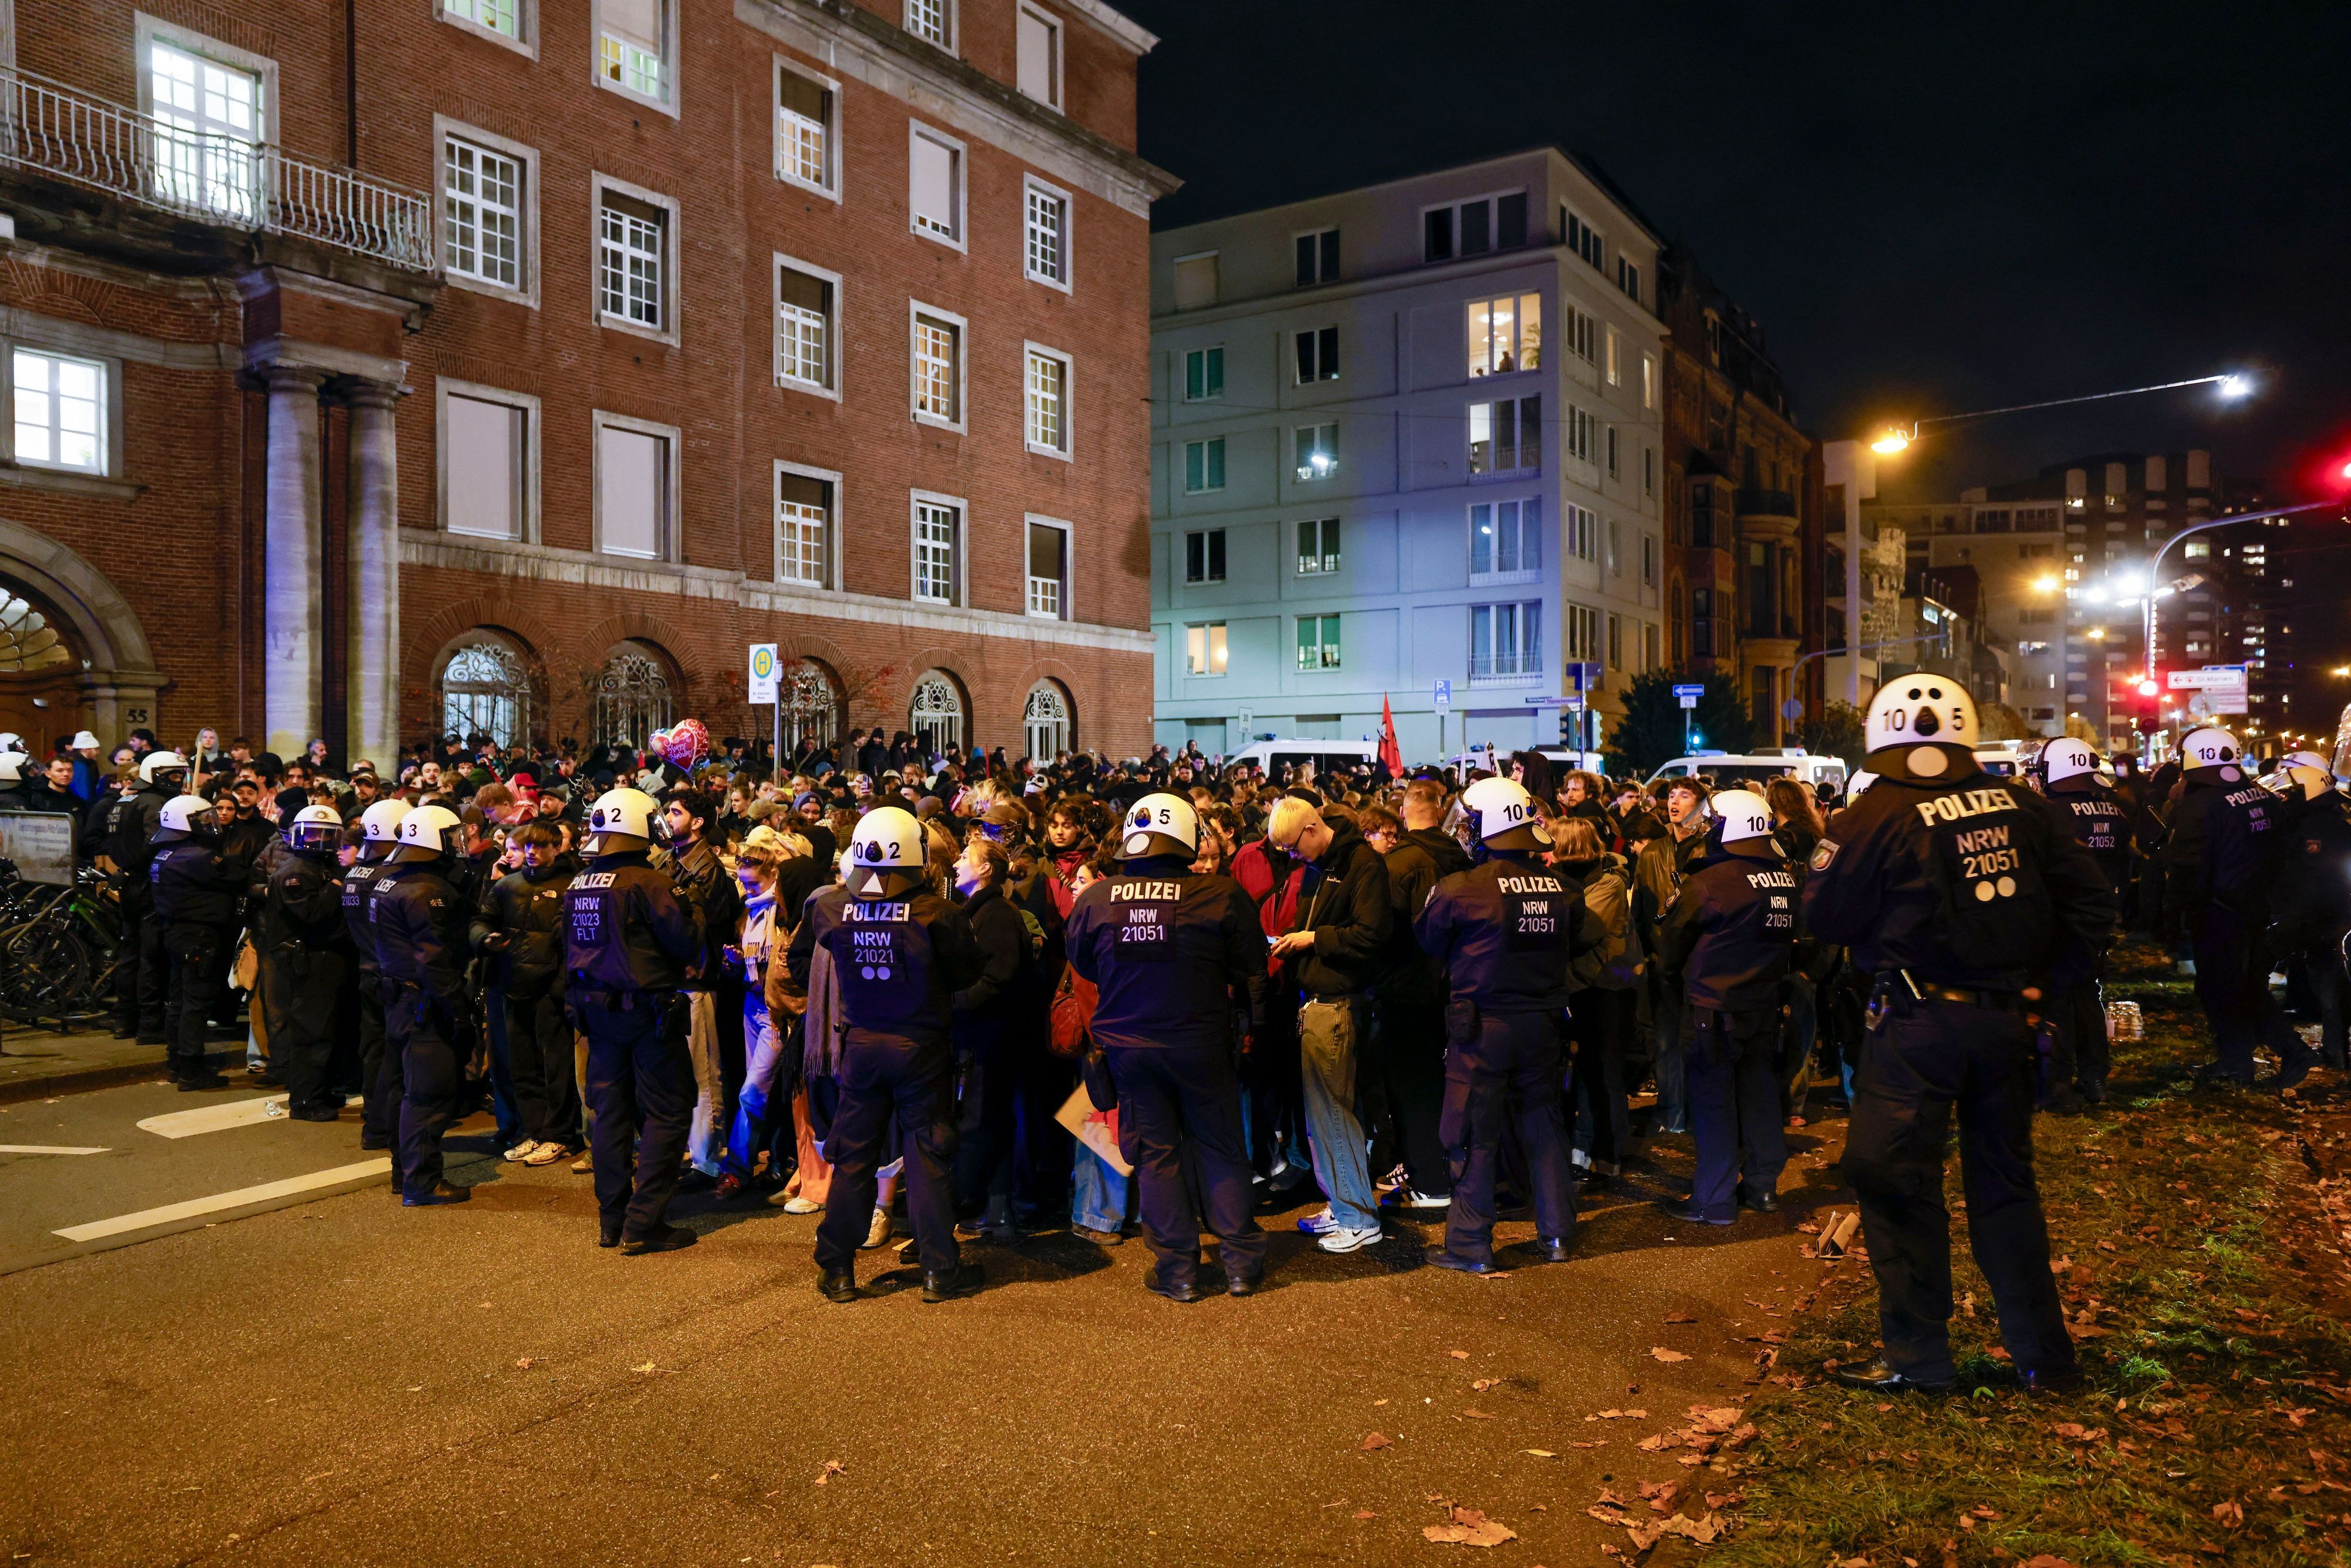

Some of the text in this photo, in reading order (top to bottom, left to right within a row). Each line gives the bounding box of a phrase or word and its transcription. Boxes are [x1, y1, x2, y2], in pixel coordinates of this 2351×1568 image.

[1436, 681, 1444, 692] P
[126, 708, 147, 723] 55
[1243, 713, 1248, 722] 30
[1883, 708, 1965, 732] 10 5
[667, 743, 686, 753] Happy
[2198, 748, 2215, 760] 10
[668, 749, 693, 762] Birthday
[2069, 753, 2087, 766] 10
[1503, 804, 1523, 822] 10
[1915, 789, 2019, 826] POLIZEI
[163, 811, 169, 821] 2
[611, 808, 621, 823] 2
[1159, 809, 1170, 825] 5
[371, 824, 380, 836] 3
[408, 824, 417, 837] 3
[1747, 816, 1765, 832] 10
[2094, 822, 2109, 833] NRW
[1956, 825, 2009, 855] NRW
[2088, 836, 2115, 848] 21052
[889, 842, 901, 859] 2
[1962, 847, 2019, 878] 21051
[567, 873, 617, 890] POLIZEI
[1498, 876, 1562, 893] POLIZEI
[1747, 872, 1796, 889] POLIZEI
[346, 883, 356, 893] NRW
[1110, 882, 1181, 902] POLIZEI
[341, 895, 360, 906] 21033
[575, 897, 600, 910] NRW
[1522, 901, 1548, 914] NRW
[1770, 896, 1788, 909] NRW
[572, 913, 600, 926] 21023
[842, 903, 910, 922] POLIZEI
[1130, 909, 1157, 923] NRW
[1518, 917, 1555, 933] 21051
[1766, 913, 1793, 927] 21051
[577, 927, 596, 940] FLT
[853, 932, 891, 947] NRW
[1121, 924, 1164, 942] 21051
[855, 949, 893, 964] 21021
